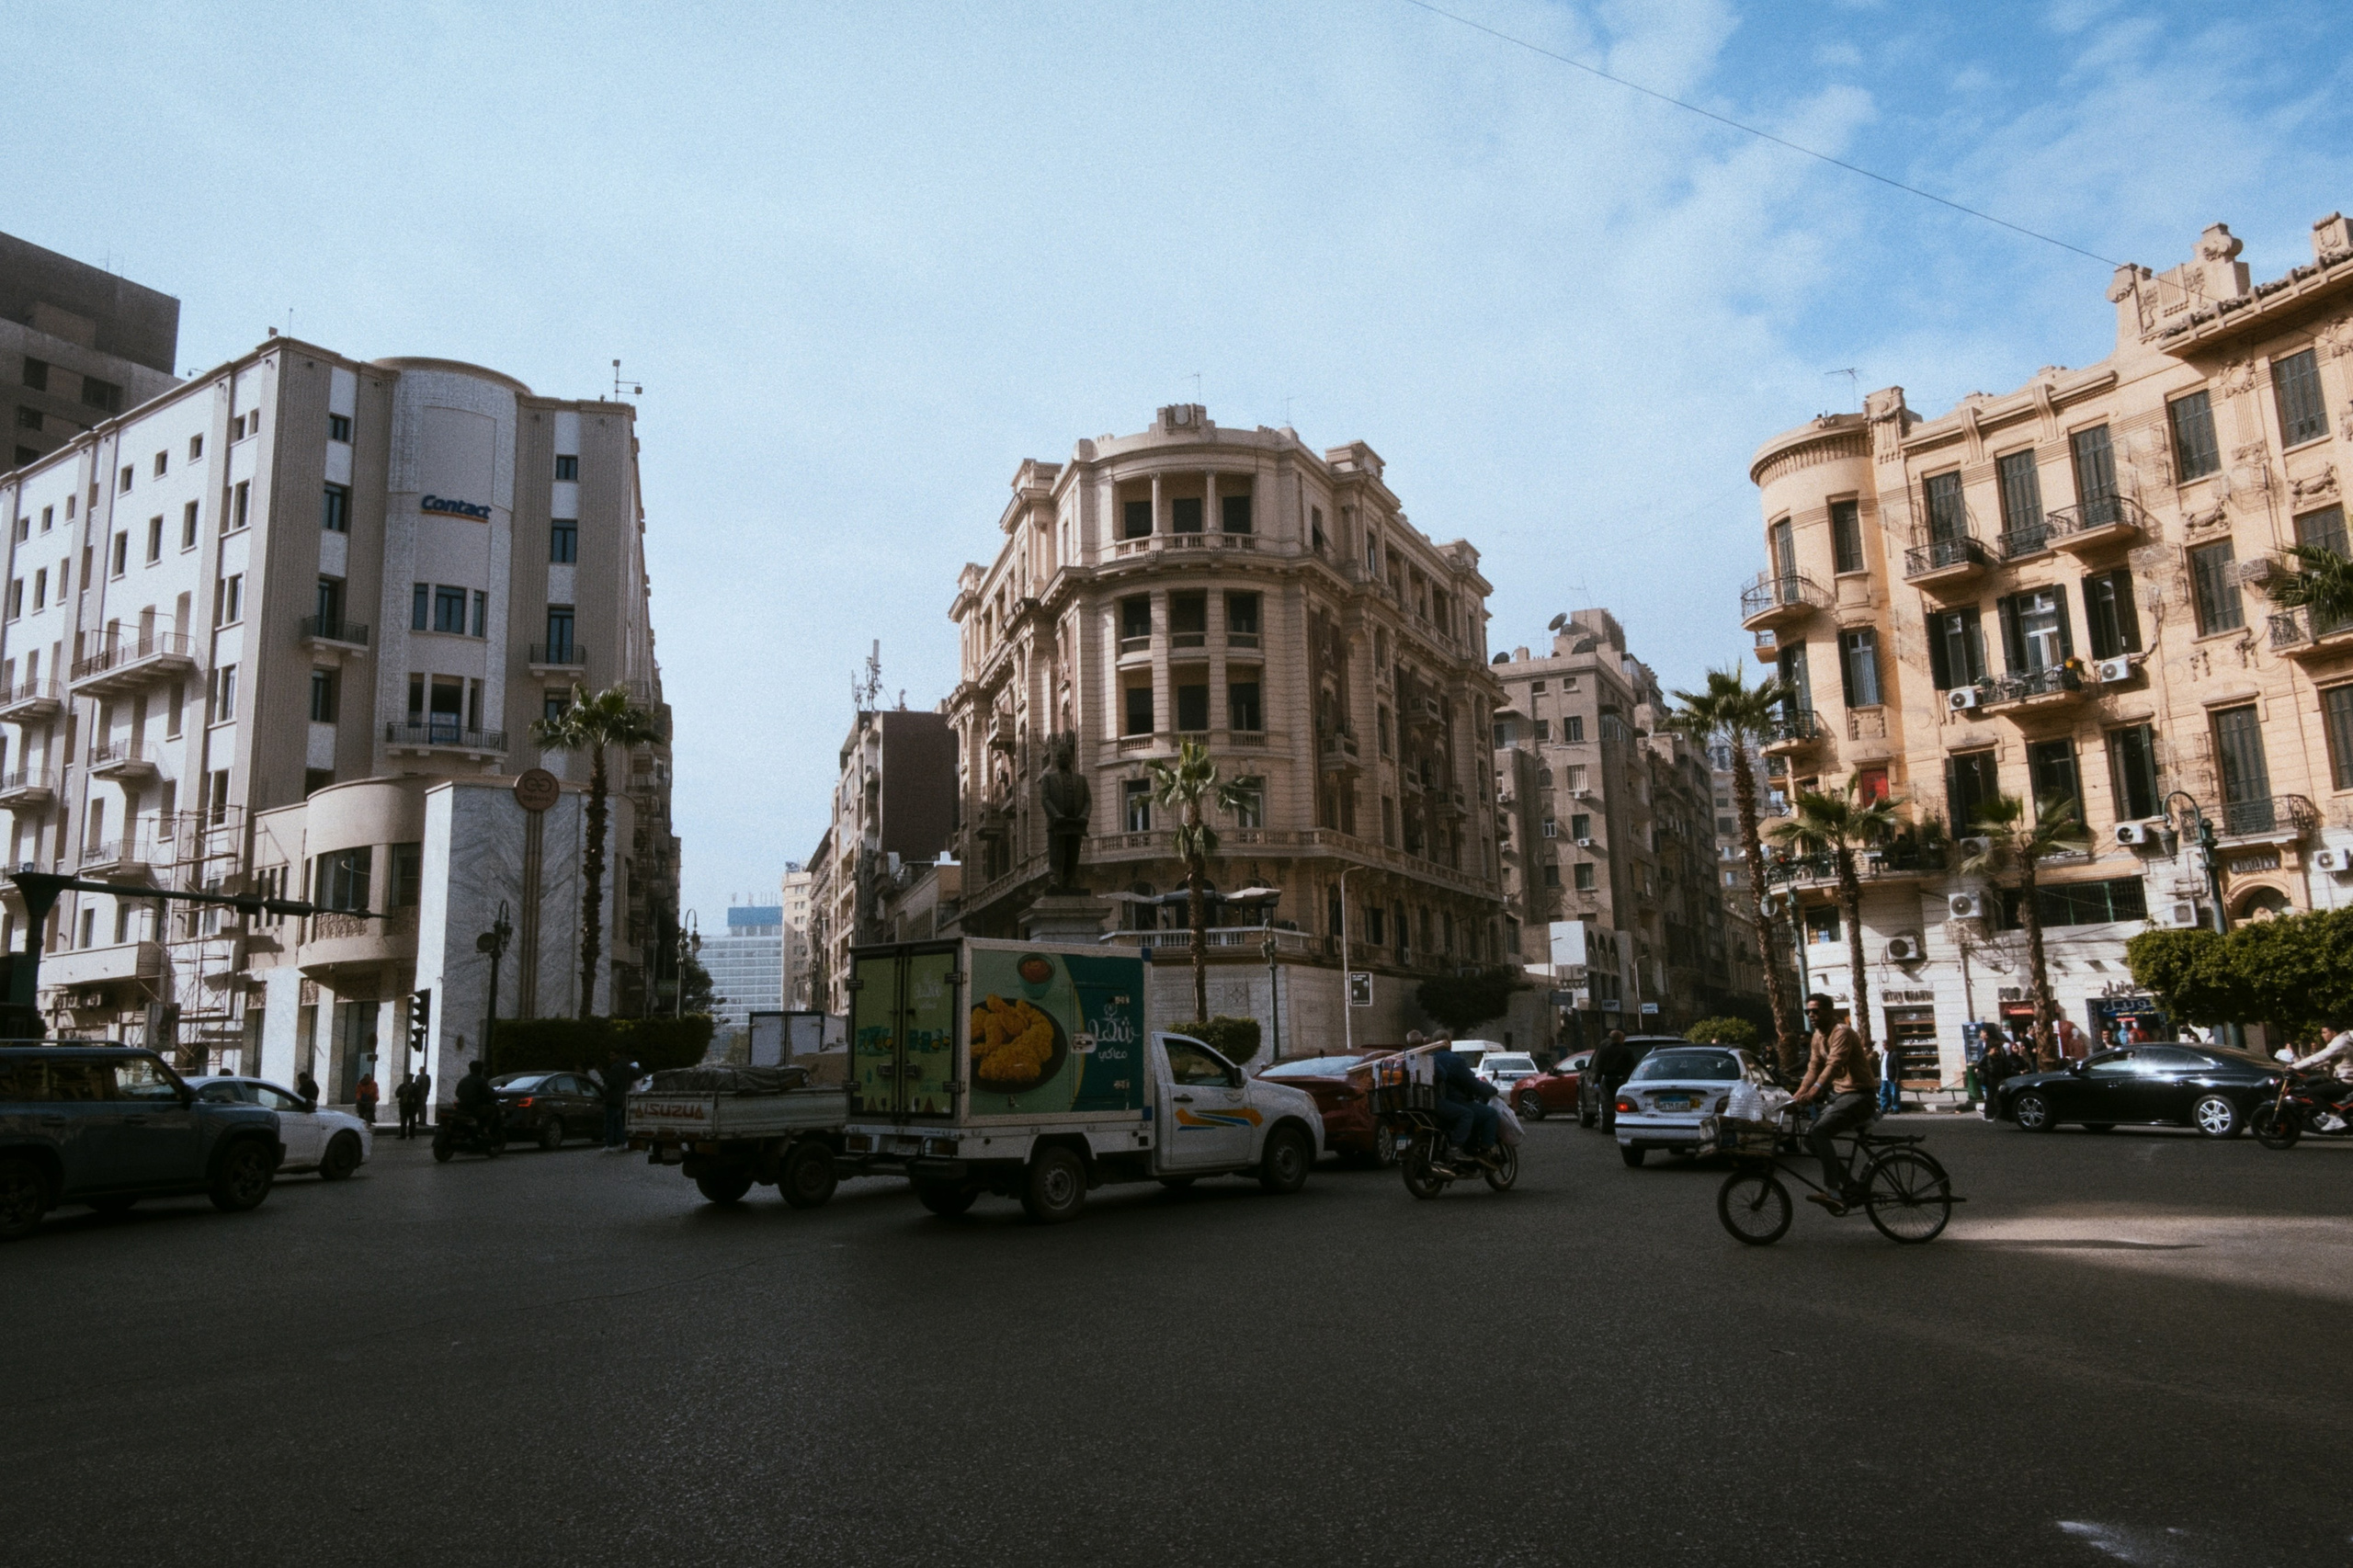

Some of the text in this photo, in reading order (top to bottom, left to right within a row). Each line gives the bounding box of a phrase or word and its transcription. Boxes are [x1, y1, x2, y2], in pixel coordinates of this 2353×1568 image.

[422, 494, 492, 519] Contact
[1098, 1048, 1128, 1062] معاكي
[644, 1103, 694, 1119] ISUZU
